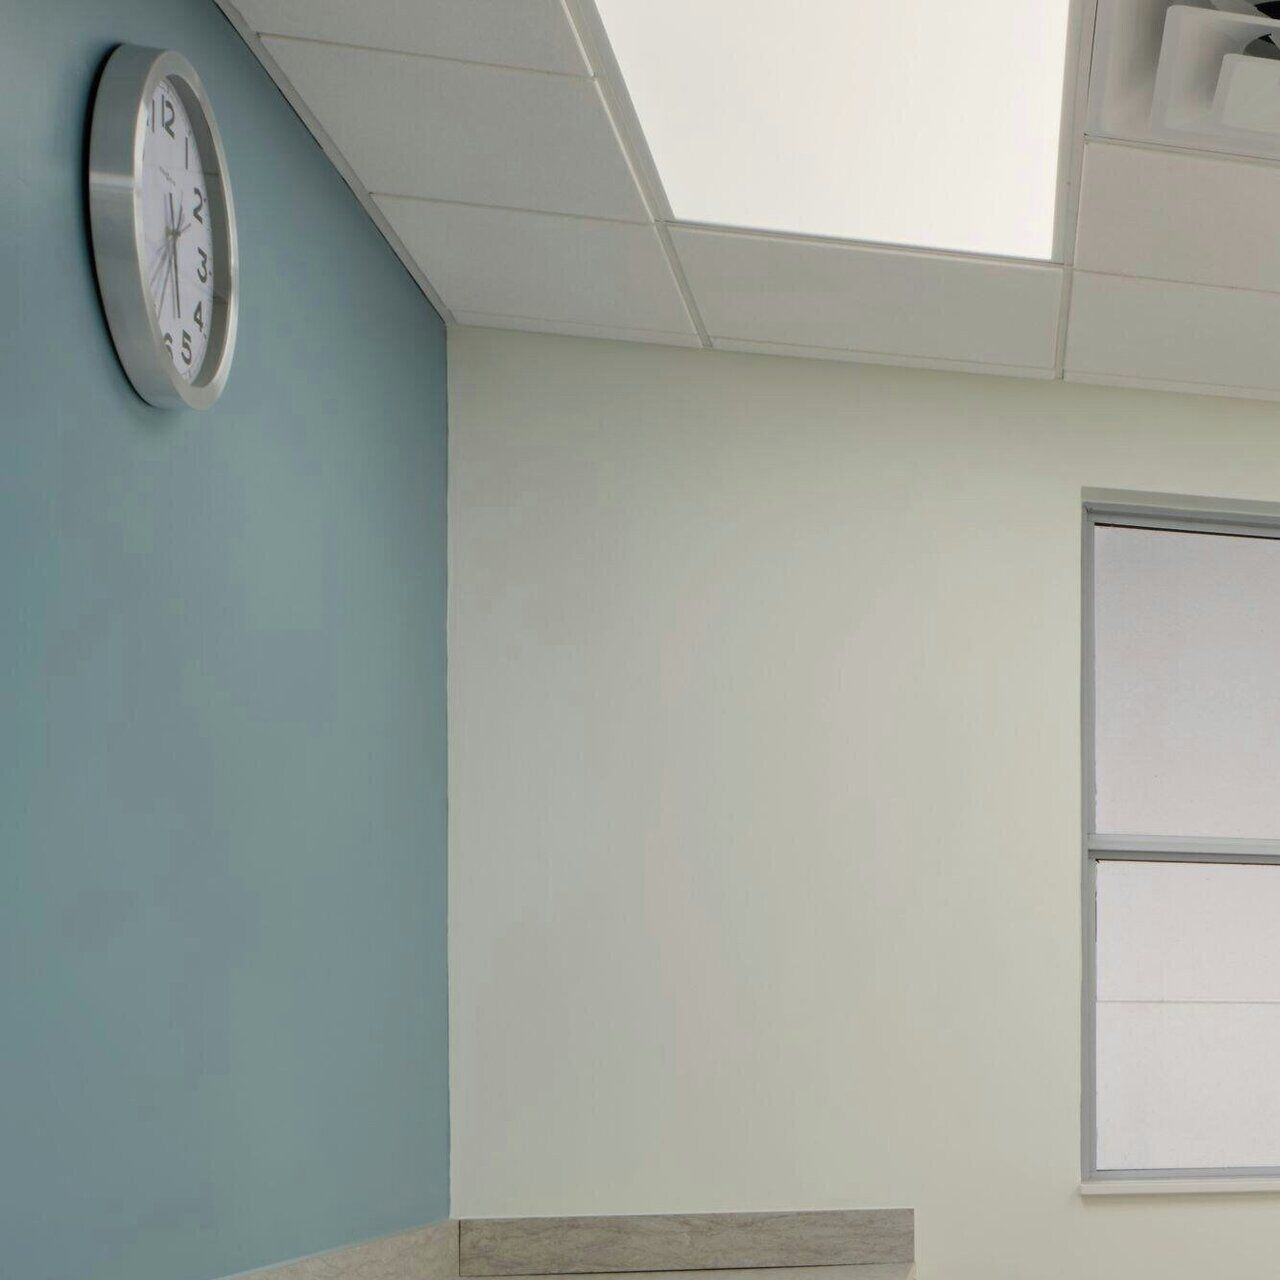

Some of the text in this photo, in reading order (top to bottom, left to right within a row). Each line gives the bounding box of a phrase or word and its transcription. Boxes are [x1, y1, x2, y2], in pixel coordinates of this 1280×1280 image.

[193, 187, 203, 224] 2
[197, 246, 207, 283] 3
[193, 300, 204, 333] 4
[181, 329, 192, 365] 5
